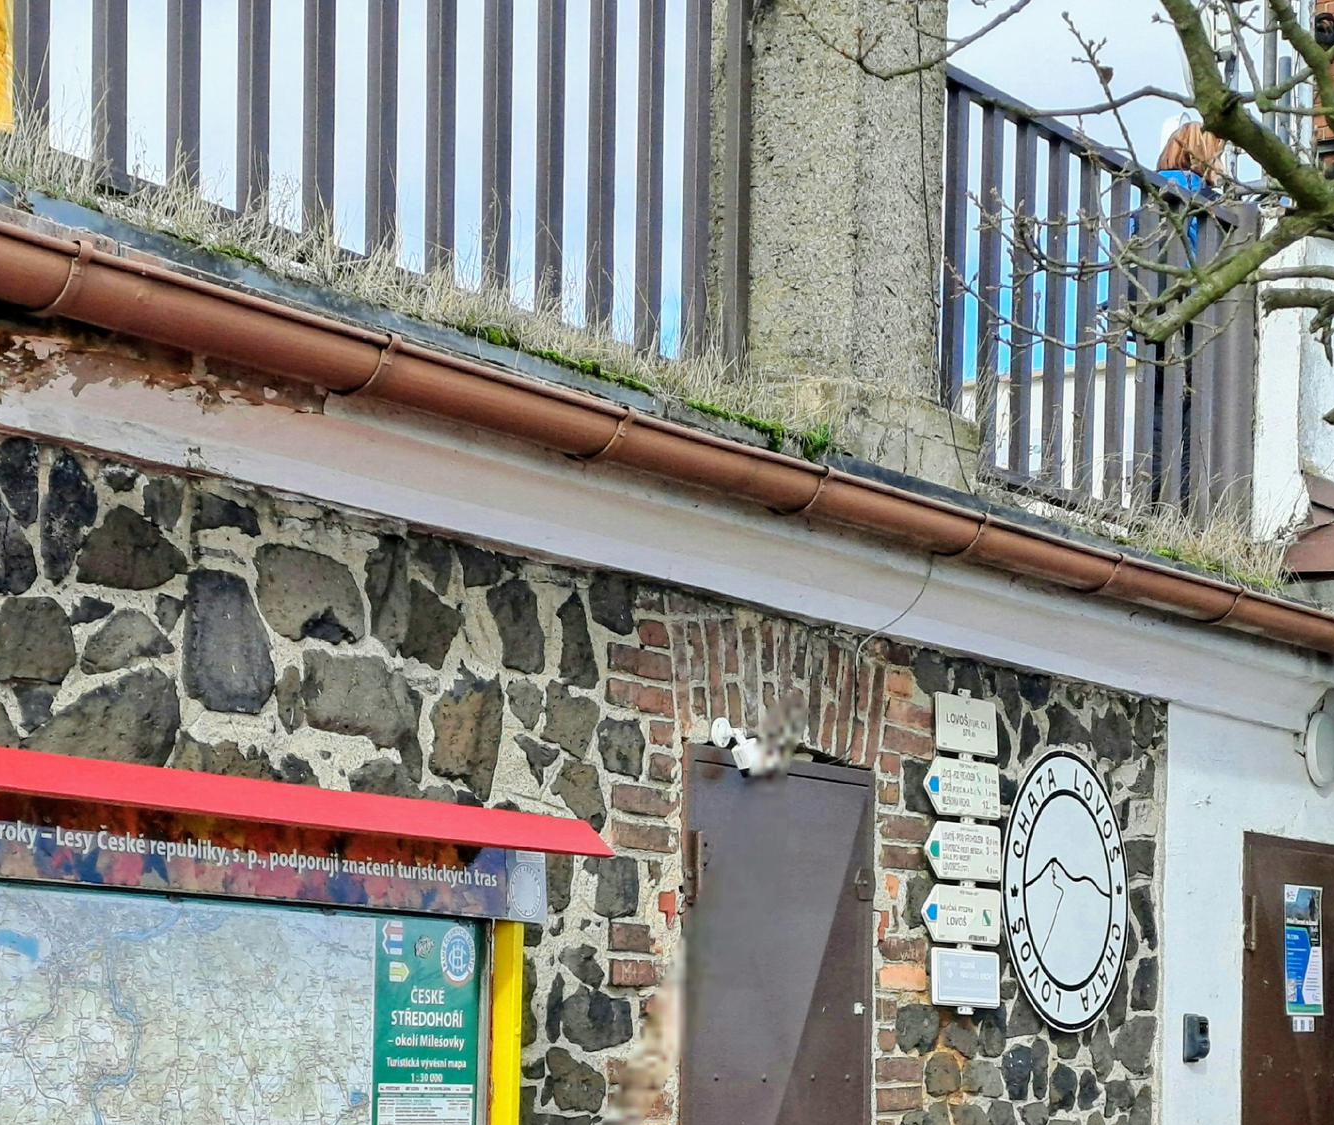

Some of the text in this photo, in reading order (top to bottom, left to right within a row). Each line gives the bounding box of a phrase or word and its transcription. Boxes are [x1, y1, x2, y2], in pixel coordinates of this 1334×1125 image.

[1012, 767, 1057, 859] CHATA
[1073, 768, 1121, 863] LOVOŠ
[55, 825, 95, 855] Lesy
[97, 825, 146, 854] České
[150, 838, 231, 866] republiky,
[232, 849, 245, 863] s.
[247, 849, 267, 870] p.,
[342, 856, 395, 878] značení
[396, 861, 472, 888] turistických
[474, 868, 498, 888] tras
[1010, 916, 1122, 1013] CHATA LOVOŠ
[410, 985, 445, 1005] ČESKÉ
[390, 1007, 464, 1028] STŘEDOHOŘÍ
[395, 1033, 419, 1047] okolí
[419, 1034, 465, 1052] Milešovky
[448, 1060, 467, 1070] mapa
